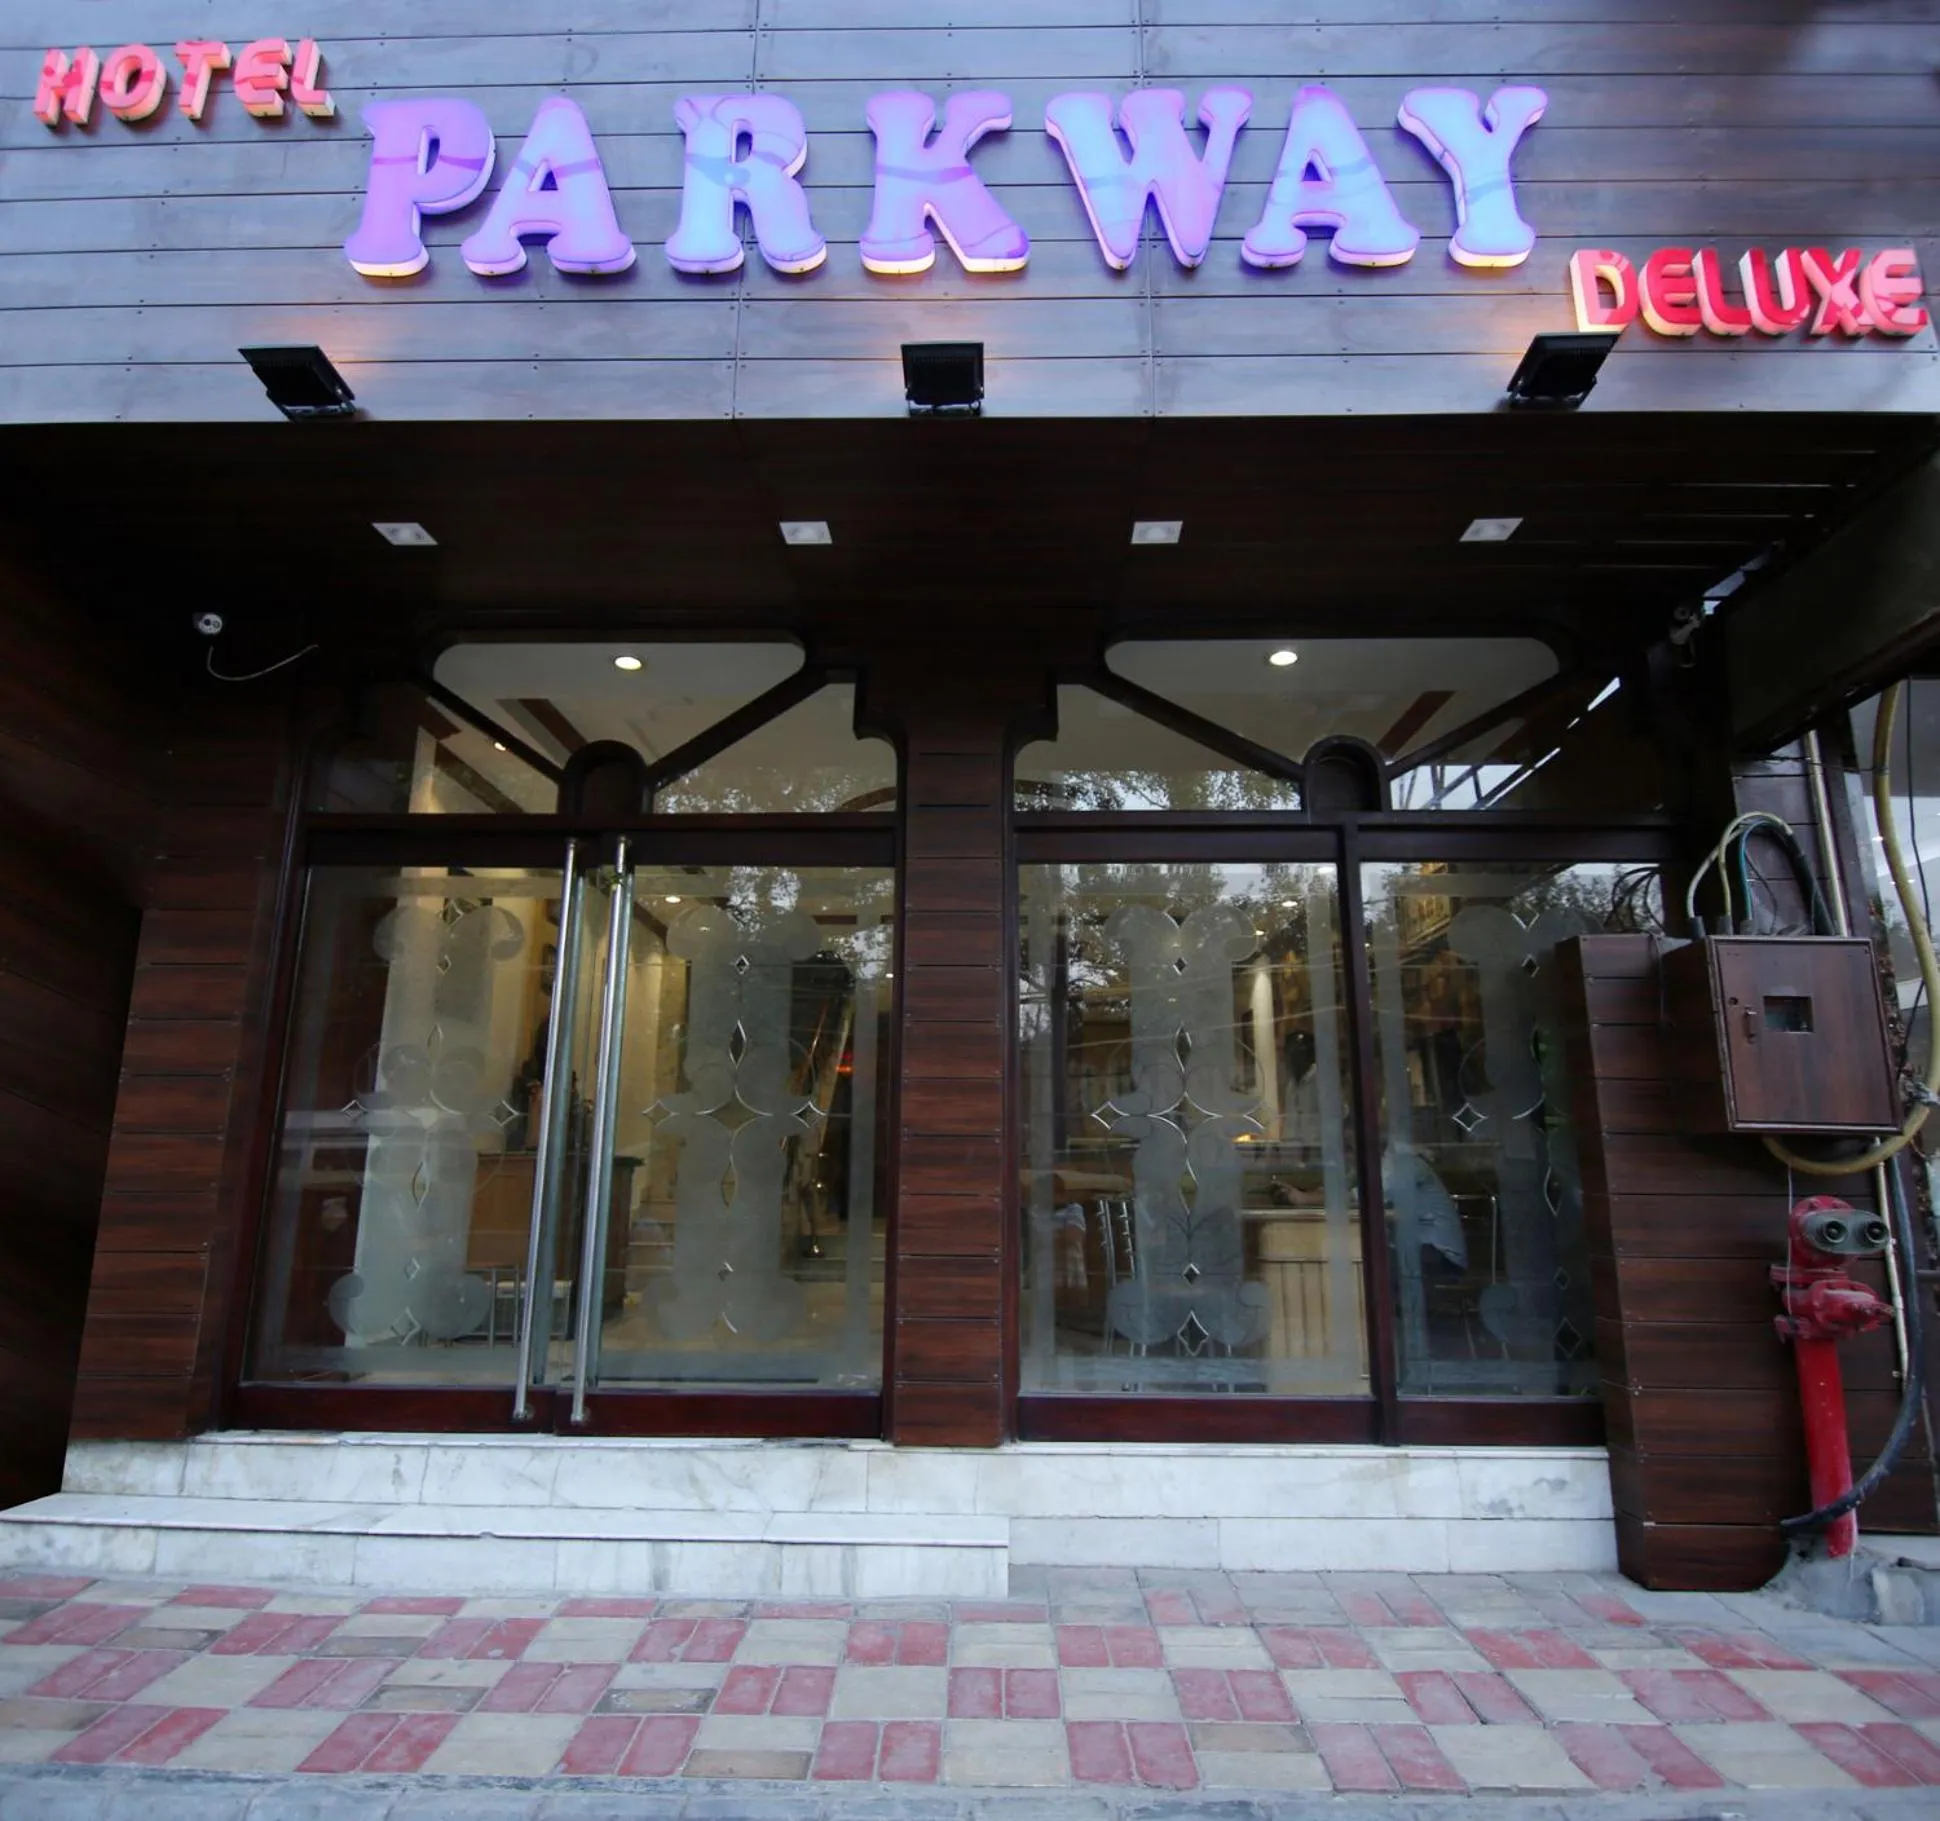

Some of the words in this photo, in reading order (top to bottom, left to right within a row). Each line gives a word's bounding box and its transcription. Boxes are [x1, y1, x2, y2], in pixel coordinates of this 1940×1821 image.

[34, 38, 336, 127] HOTEL
[343, 85, 1549, 278] PARKWAY
[1569, 247, 1929, 337] DELUXE
